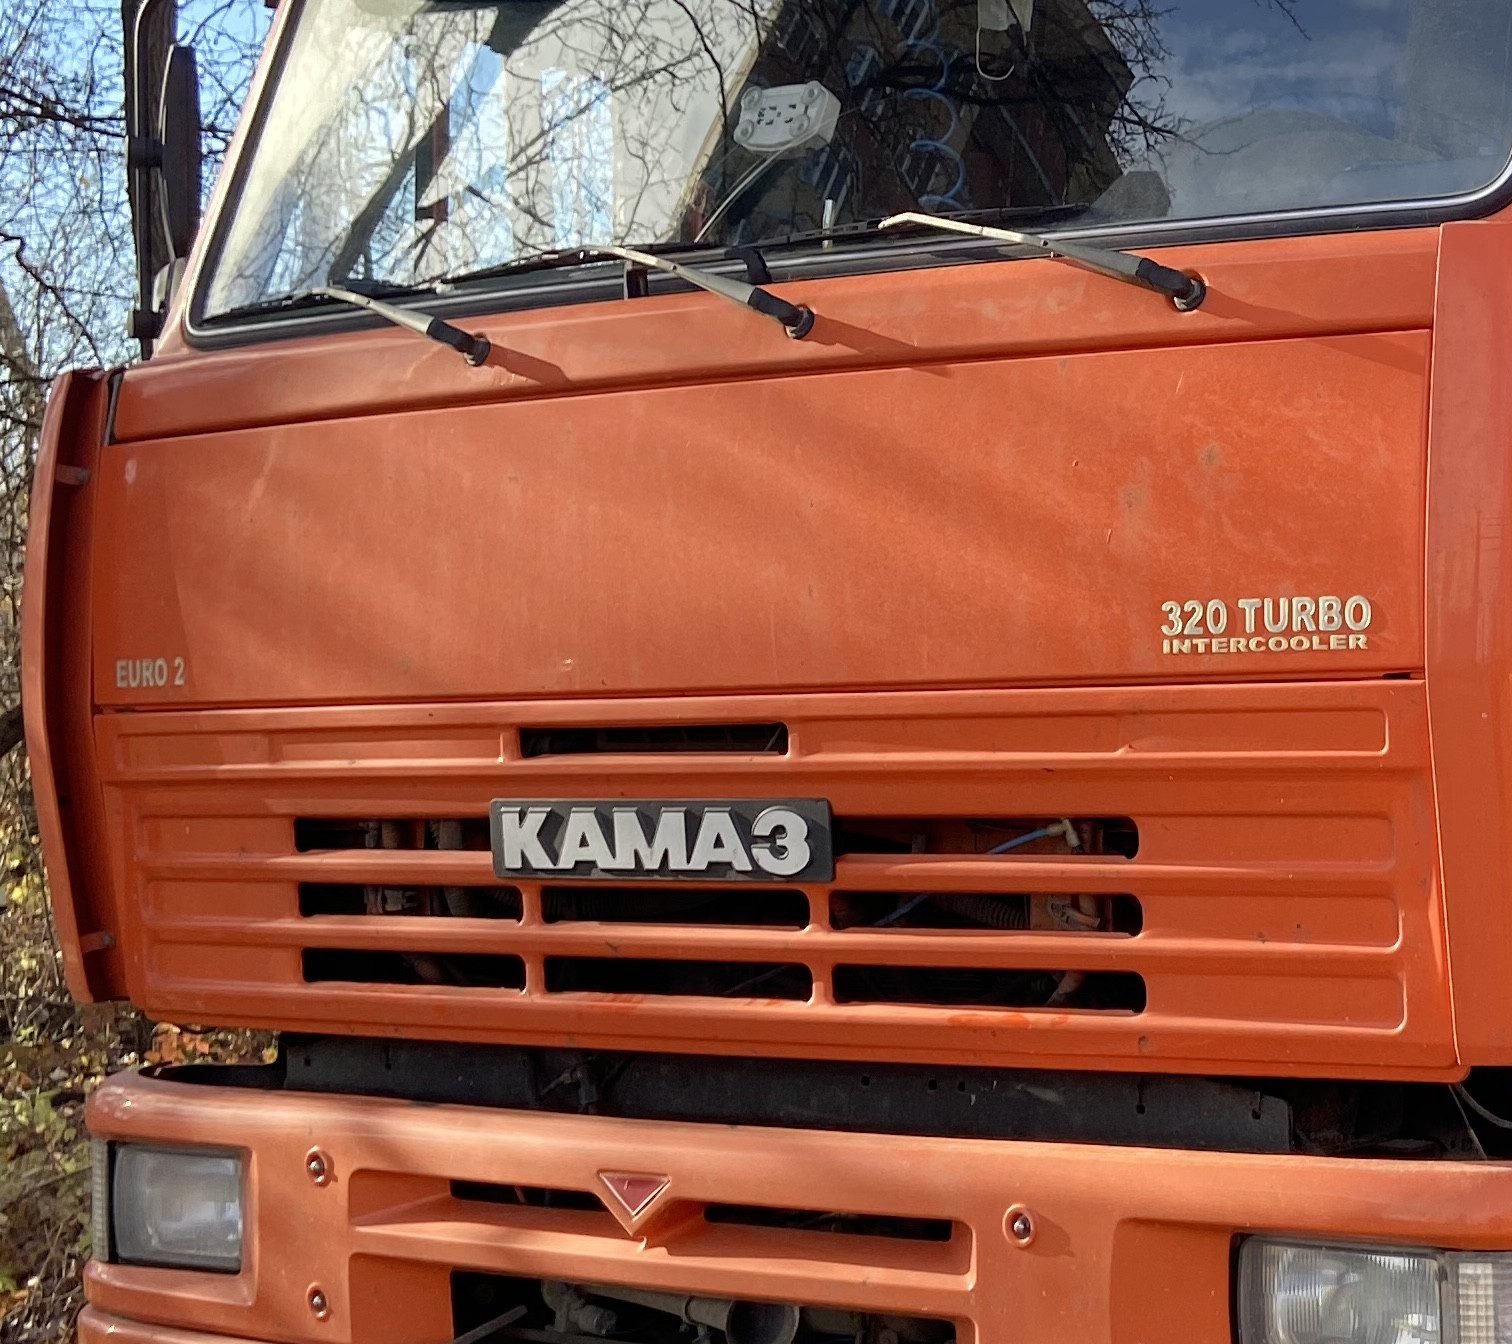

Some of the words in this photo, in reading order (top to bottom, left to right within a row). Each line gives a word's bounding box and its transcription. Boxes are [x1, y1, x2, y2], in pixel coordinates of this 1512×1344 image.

[1160, 599, 1228, 636] 320
[1238, 595, 1372, 633] TURBO
[1162, 634, 1369, 655] INTERCOOLER
[116, 657, 168, 688] EURO
[173, 656, 185, 686] 2
[500, 805, 811, 876] КАМАЗ
